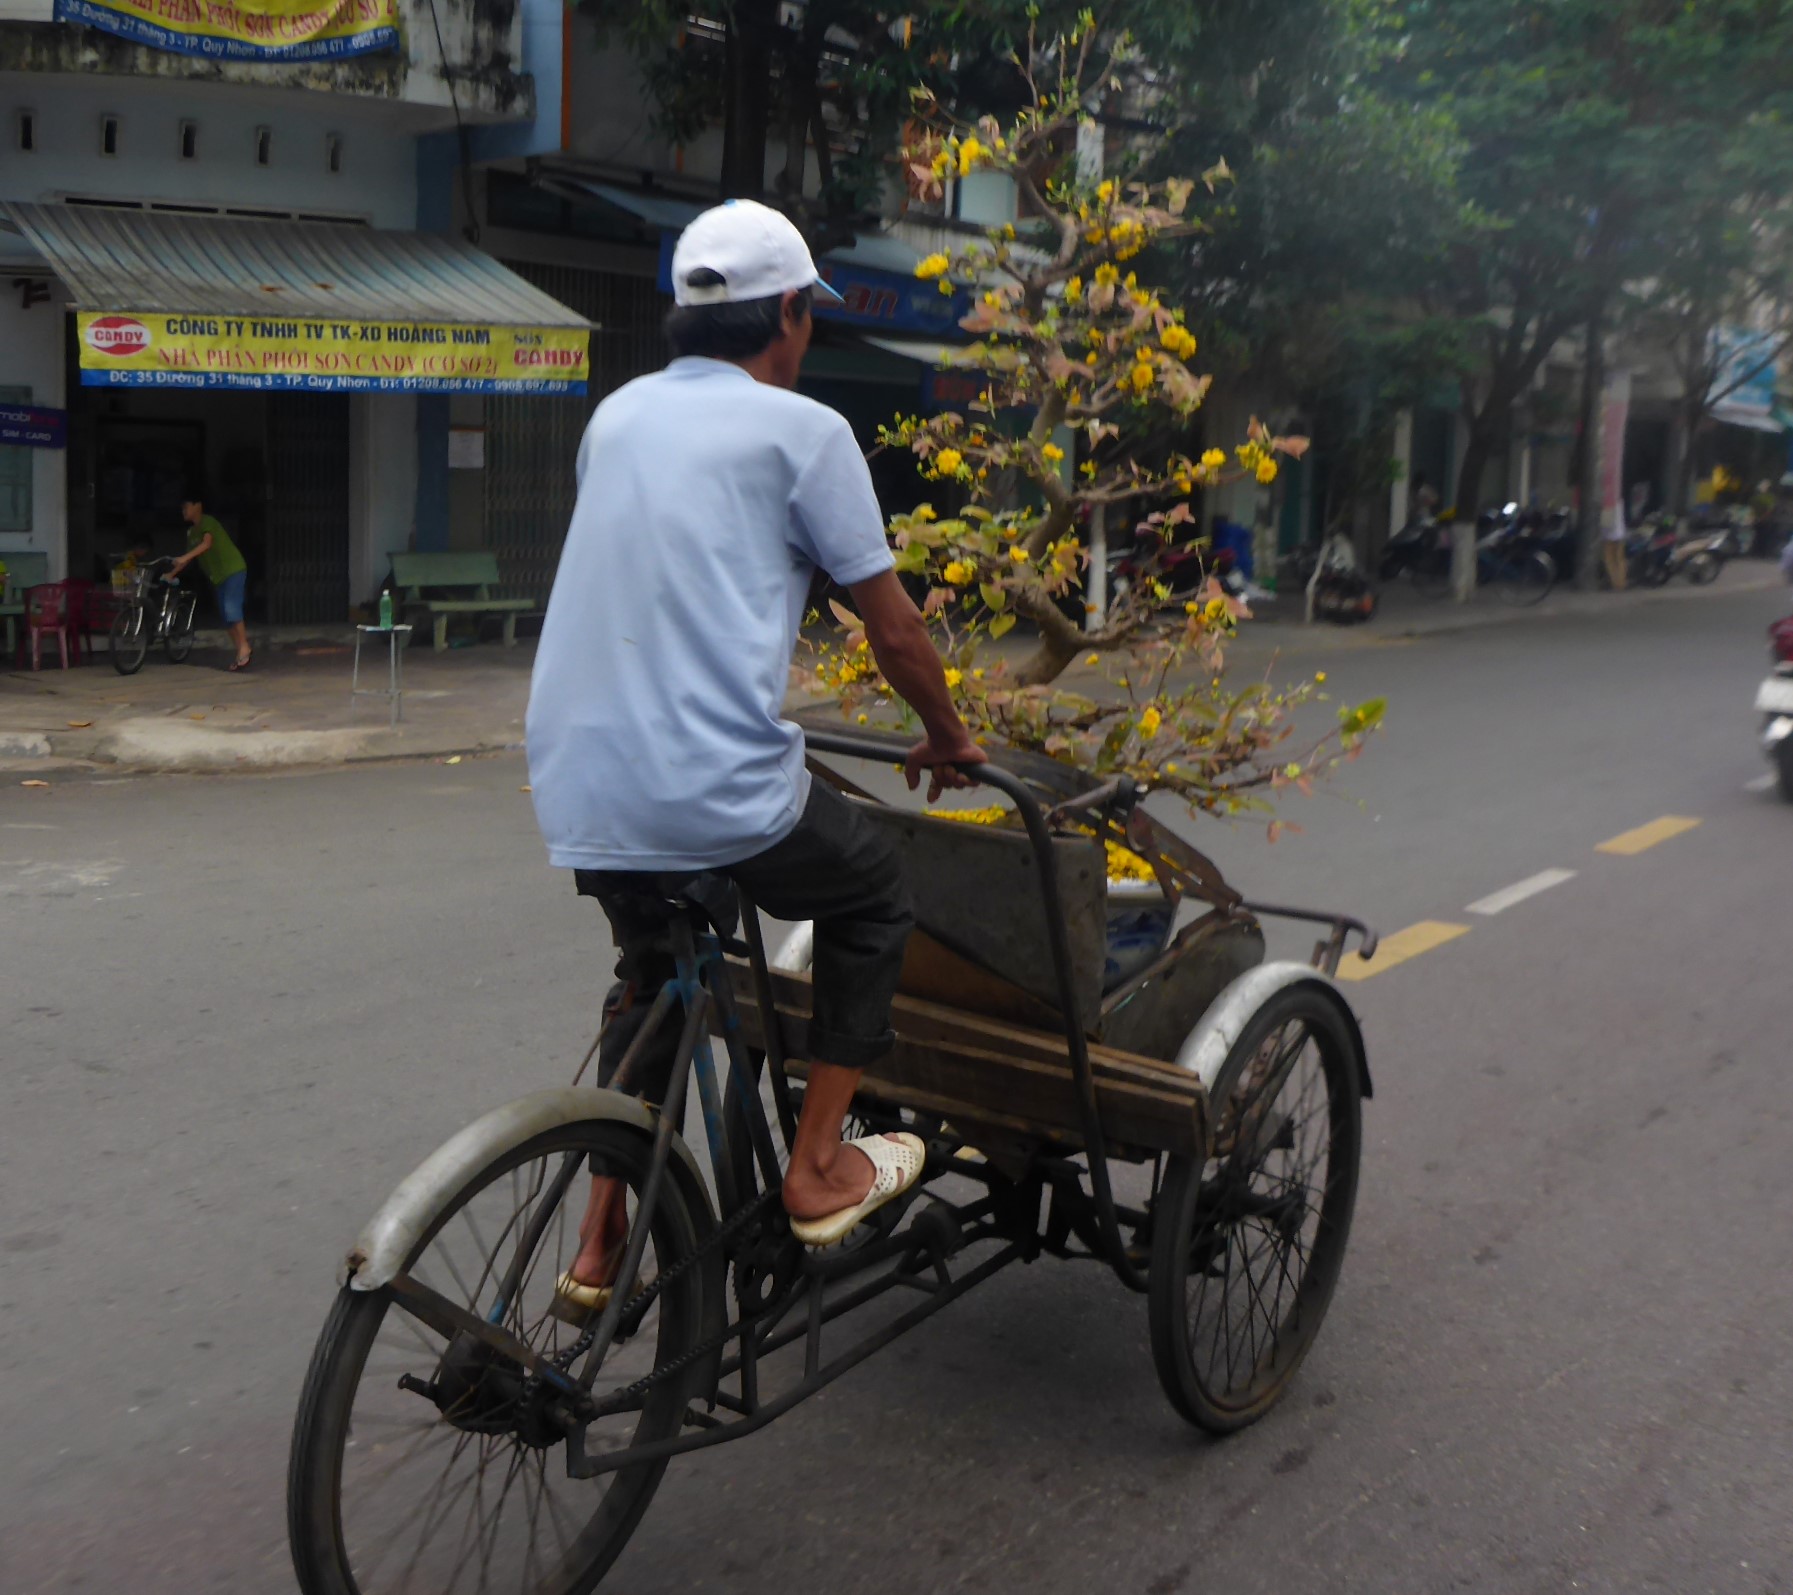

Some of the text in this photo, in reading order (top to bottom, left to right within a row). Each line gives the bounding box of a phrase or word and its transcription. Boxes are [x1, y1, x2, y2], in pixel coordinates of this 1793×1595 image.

[202, 37, 225, 58] Quy
[94, 329, 144, 343] CANDY
[165, 314, 220, 337] CÔNG
[223, 320, 245, 337] TY
[250, 321, 298, 339] TNHH
[304, 323, 324, 341] TV
[451, 328, 491, 346] NAM
[158, 341, 201, 368] NHÀ
[354, 352, 415, 374] CANDY
[513, 348, 585, 369] CANDY
[137, 371, 154, 385] 35
[156, 371, 205, 387] Đường
[208, 373, 224, 386] 31
[227, 374, 263, 390] tháng
[265, 375, 273, 387] 3
[307, 376, 334, 392] Quy
